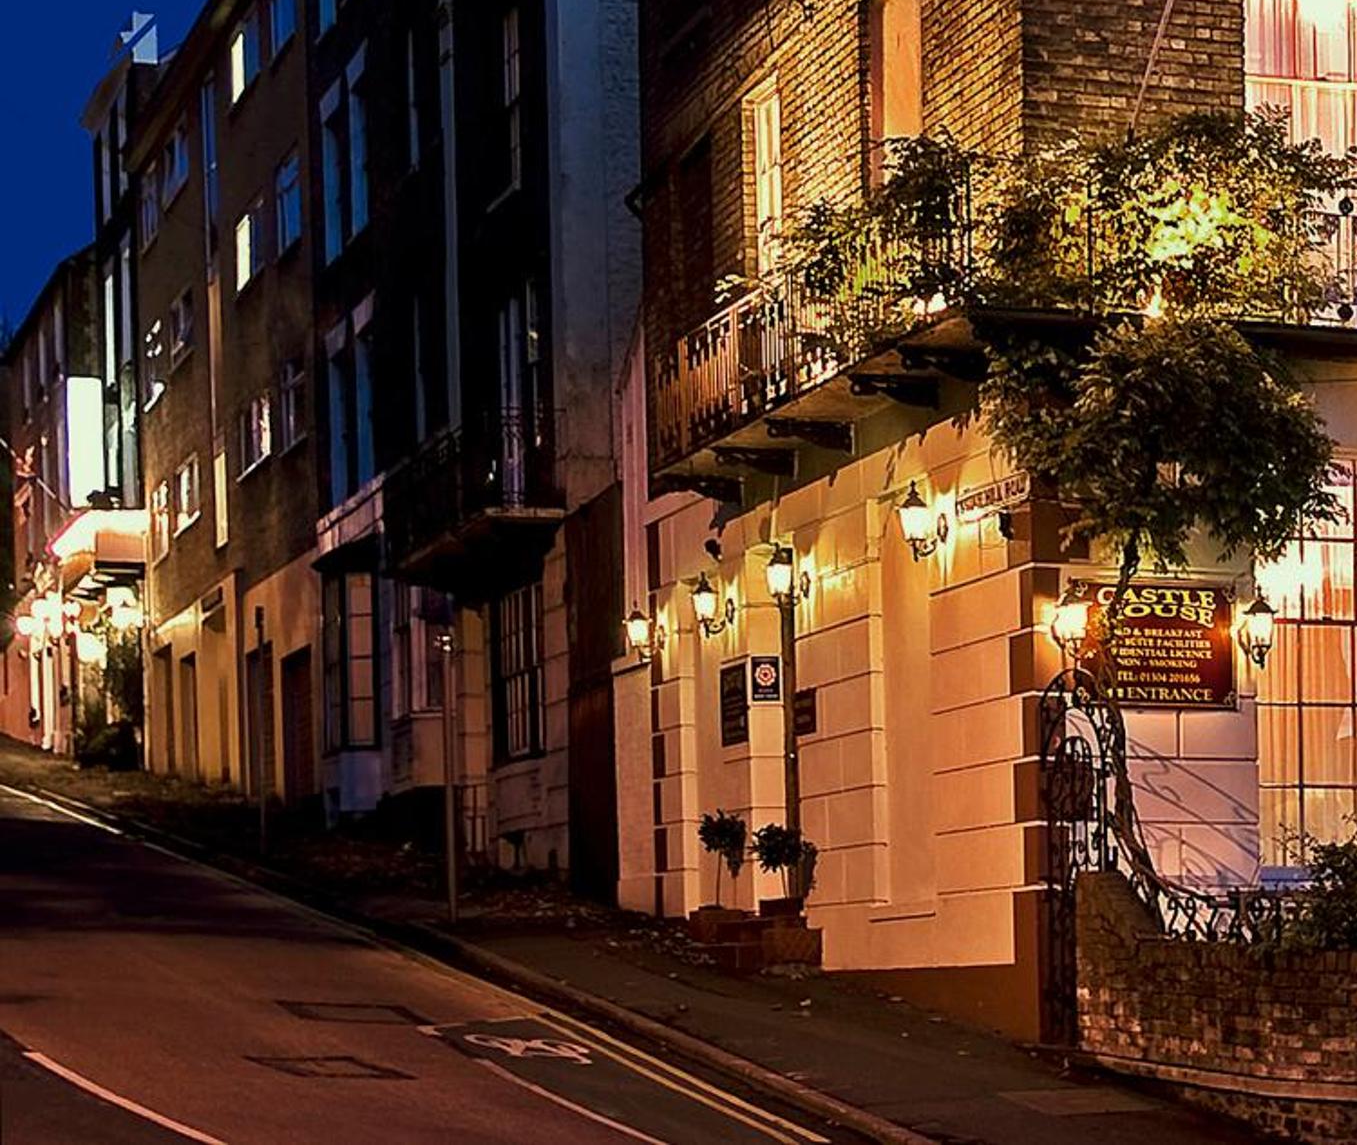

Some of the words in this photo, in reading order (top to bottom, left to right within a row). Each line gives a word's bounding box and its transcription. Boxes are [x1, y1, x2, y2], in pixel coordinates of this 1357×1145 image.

[1097, 587, 1216, 611] CASTLE
[1144, 629, 1203, 639] BREAKFAST
[1157, 639, 1212, 649] FACILITIES
[1170, 649, 1213, 659] LICENCE
[1117, 657, 1141, 667] NON
[1149, 659, 1198, 669] SMOKING
[1127, 687, 1213, 701] ENTRANCE
